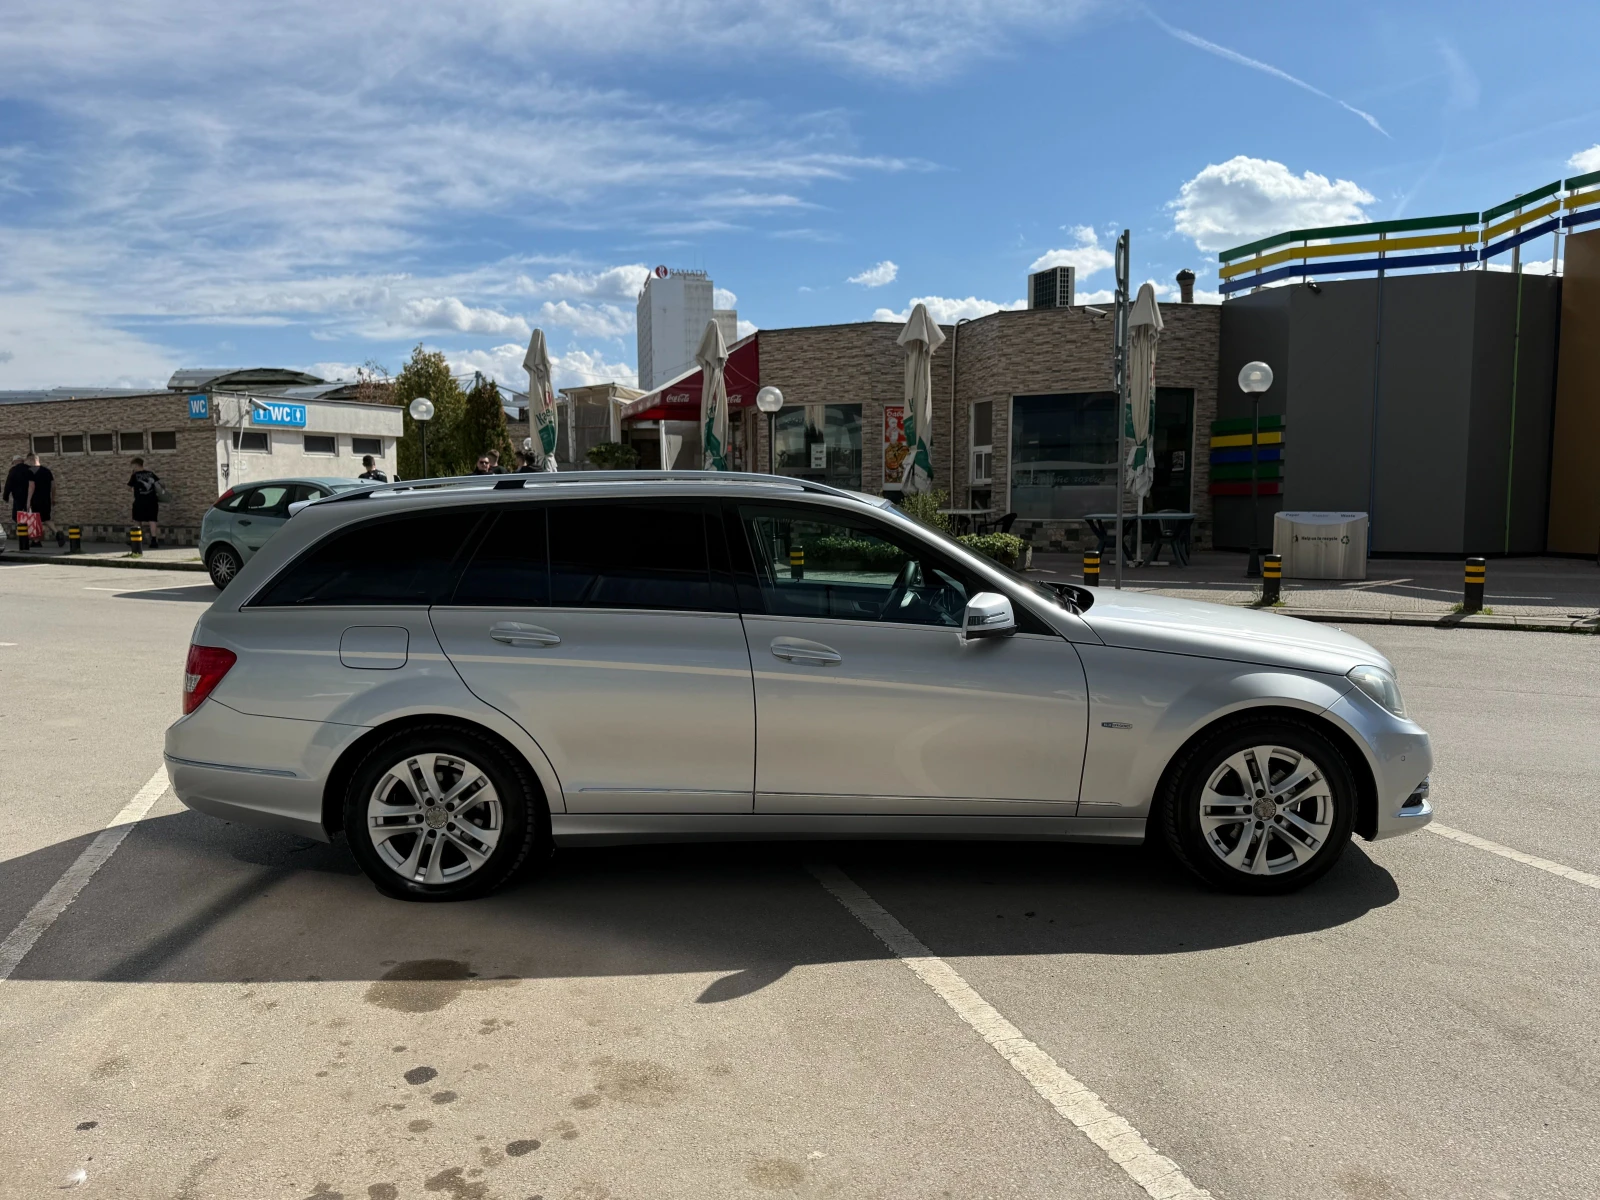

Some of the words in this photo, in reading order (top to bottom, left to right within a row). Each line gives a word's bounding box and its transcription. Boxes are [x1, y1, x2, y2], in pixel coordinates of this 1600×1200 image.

[669, 268, 709, 277] RAMADA
[190, 400, 206, 413] WC
[270, 406, 291, 422] WC
